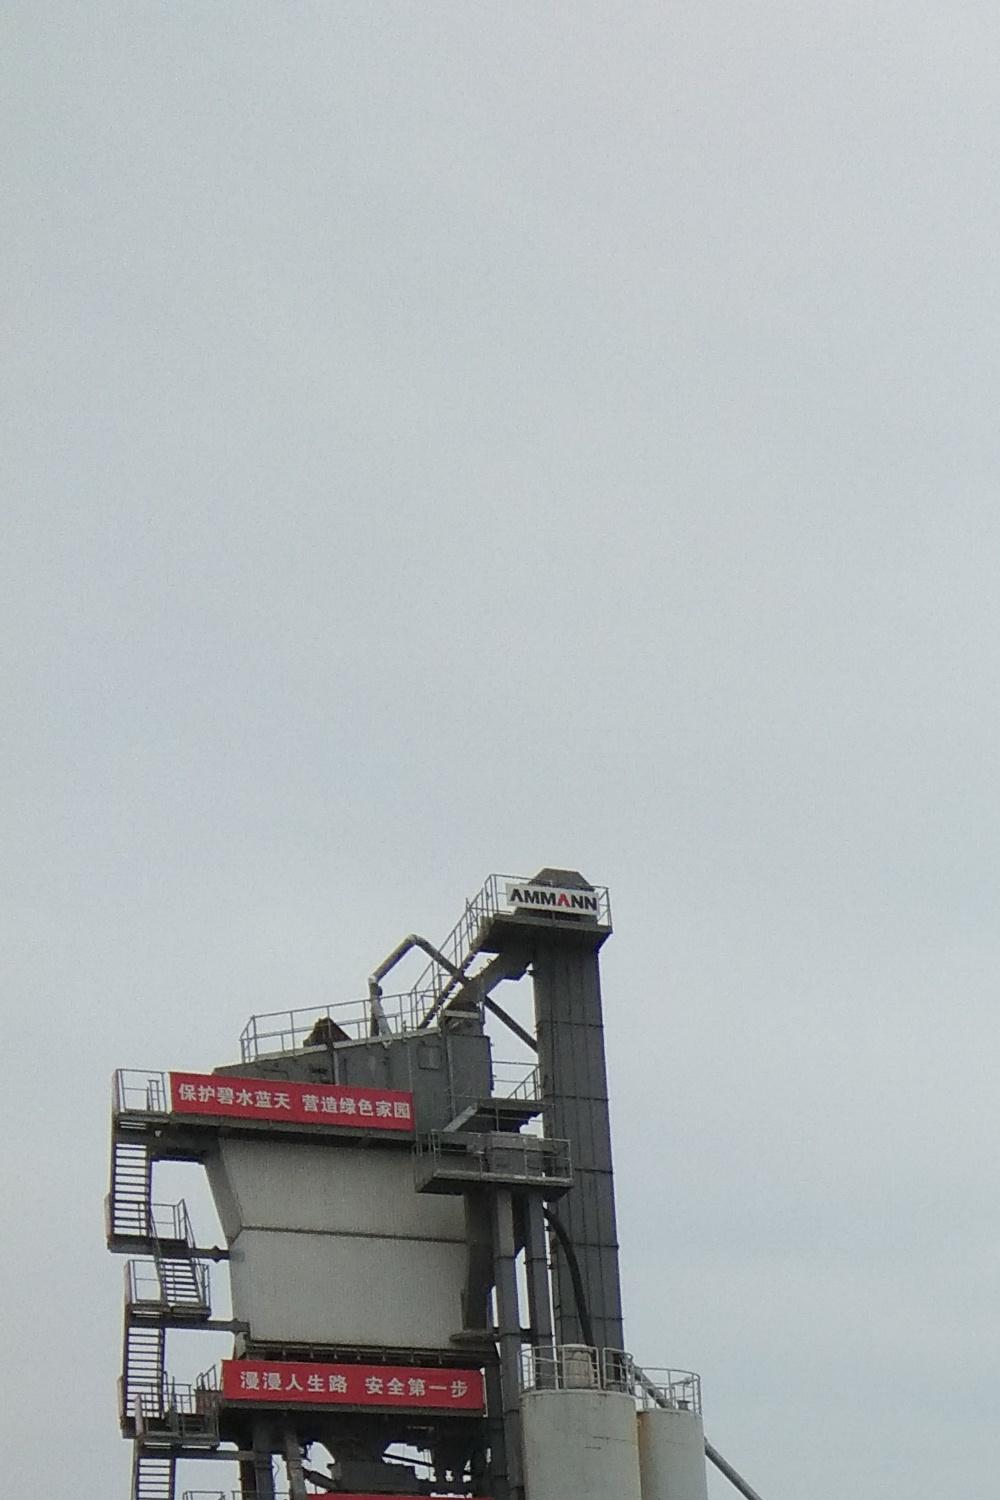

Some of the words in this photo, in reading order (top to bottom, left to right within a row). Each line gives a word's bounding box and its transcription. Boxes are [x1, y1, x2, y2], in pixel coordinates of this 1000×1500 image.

[509, 887, 598, 912] AMMANN
[178, 1082, 291, 1110] 保护碧水蓝天
[302, 1094, 411, 1120] 营造绿色家园
[240, 1370, 349, 1394] 漫漫人生路
[365, 1375, 468, 1398] 安全第一步
